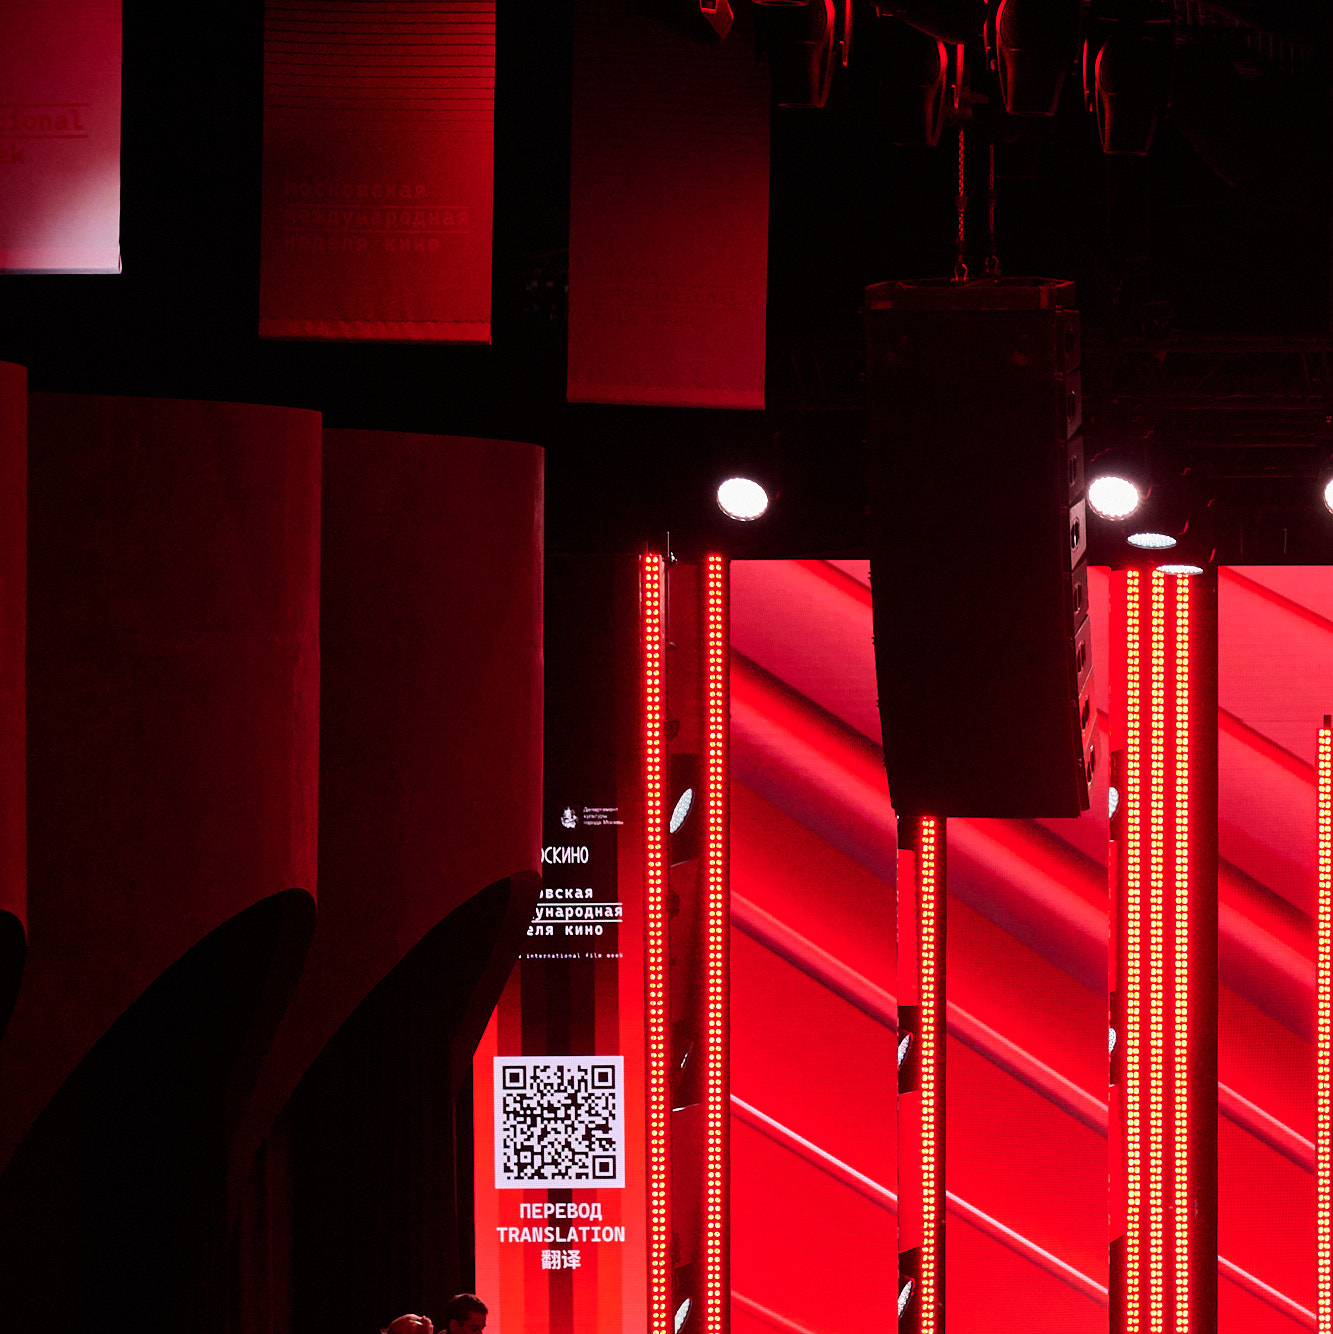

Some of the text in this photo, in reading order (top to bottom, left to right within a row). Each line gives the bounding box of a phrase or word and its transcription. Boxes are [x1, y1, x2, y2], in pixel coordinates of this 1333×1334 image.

[535, 906, 623, 920] ународная
[564, 924, 603, 936] кино
[519, 1202, 603, 1221] ПЕРЕВОД
[496, 1226, 625, 1243] TRANSLATION
[541, 1249, 581, 1270] 翻译
